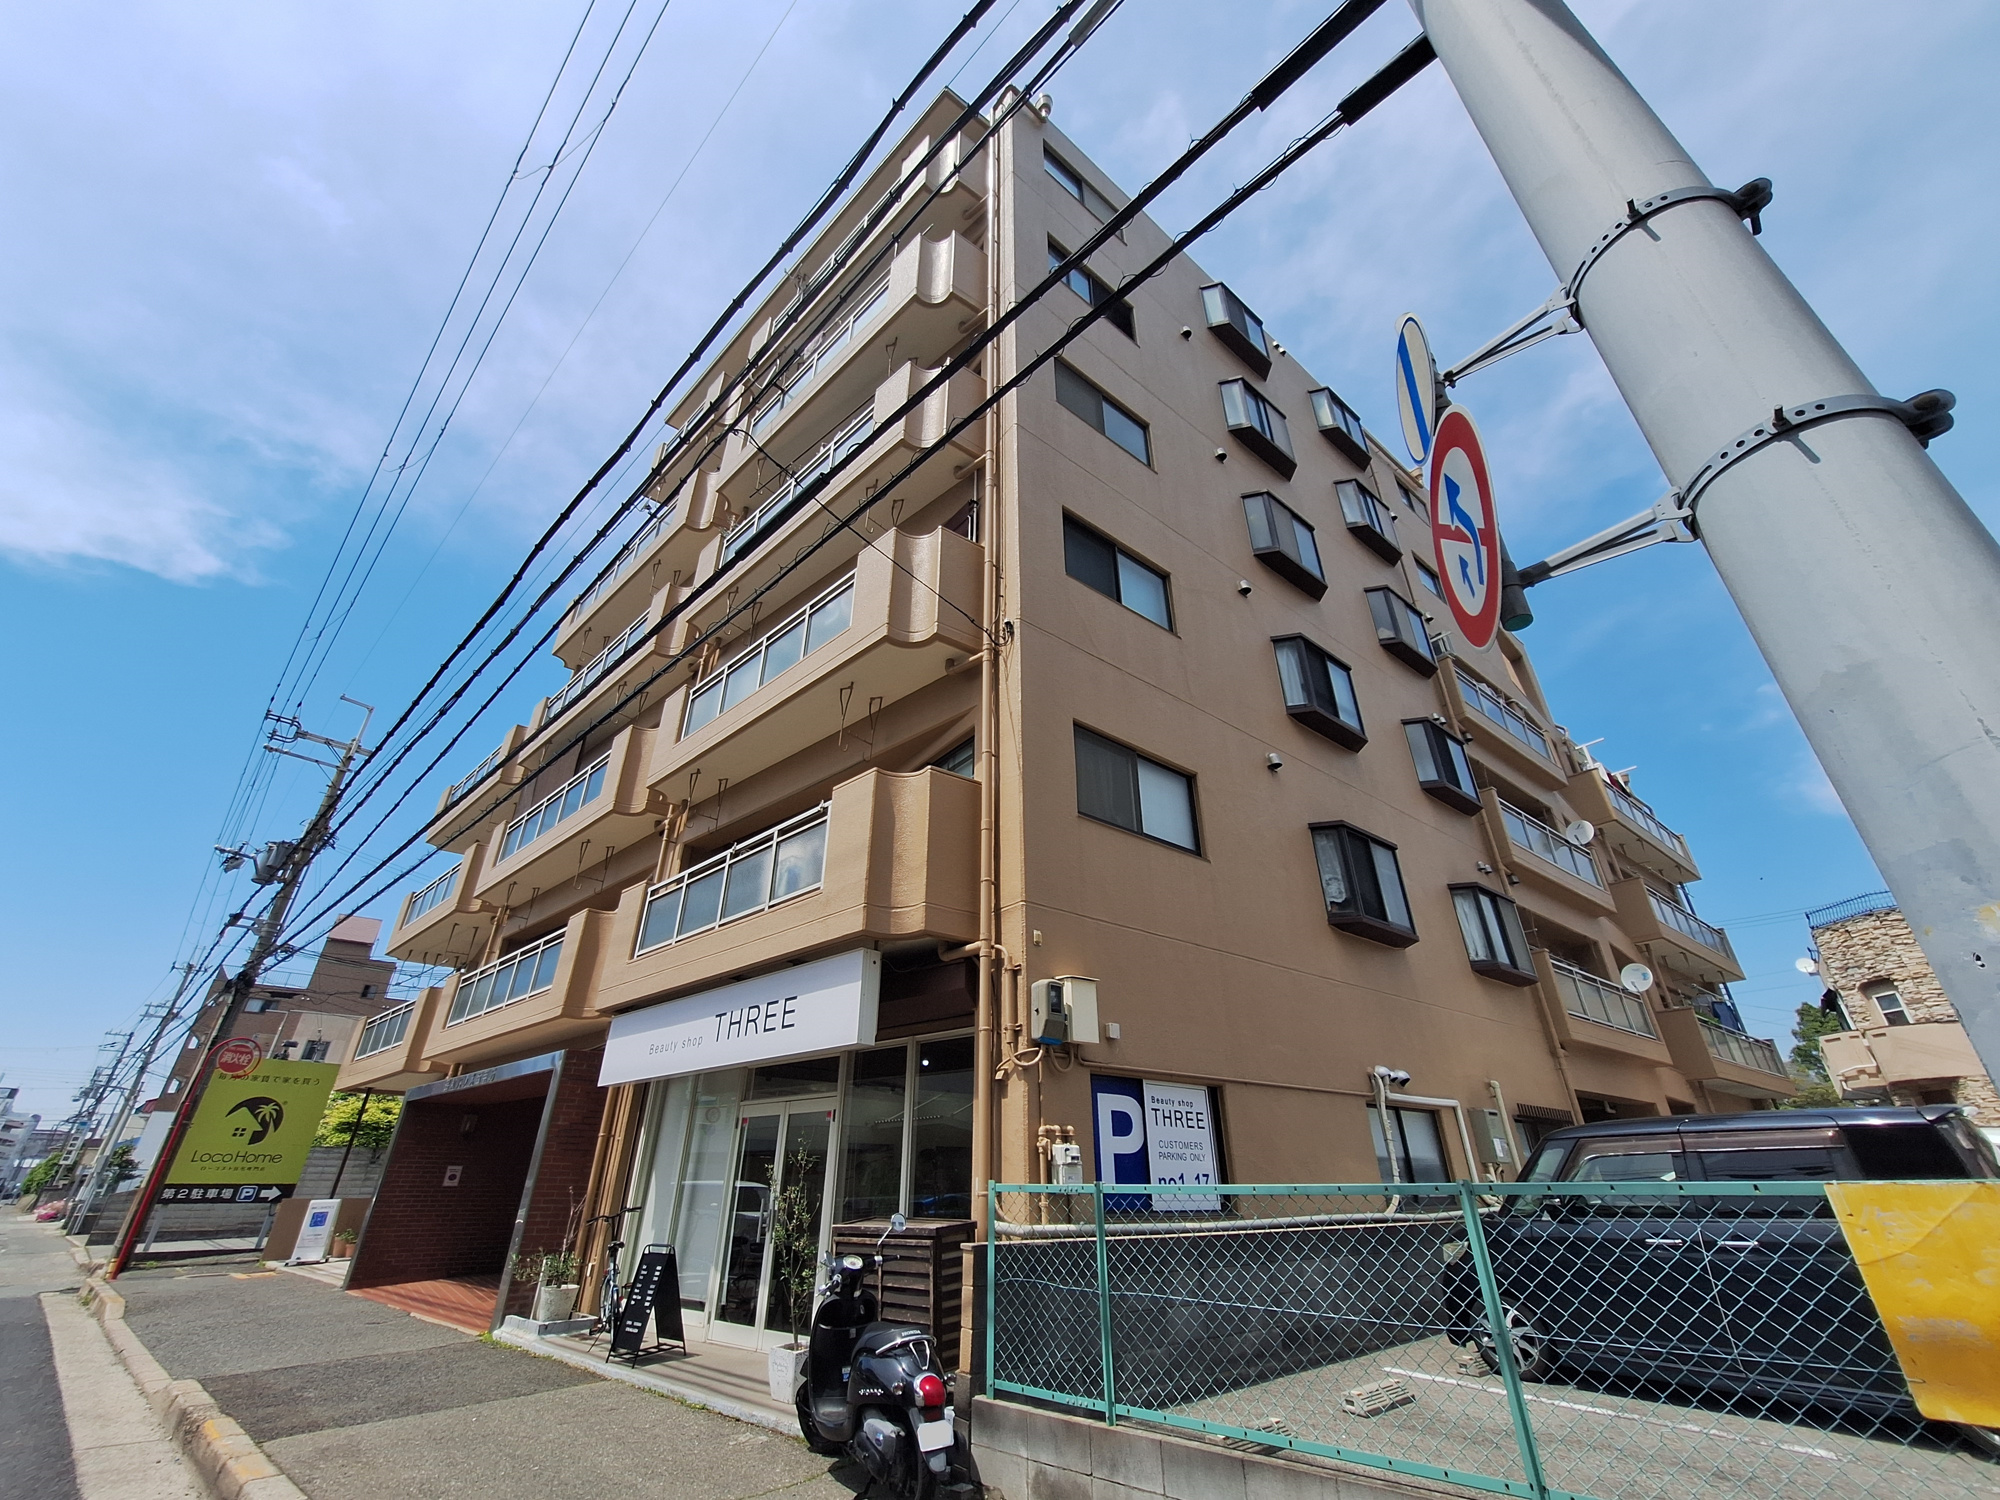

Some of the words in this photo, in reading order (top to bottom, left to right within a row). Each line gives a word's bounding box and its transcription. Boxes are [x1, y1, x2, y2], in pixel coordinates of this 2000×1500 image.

[649, 1041, 678, 1055] Beauty
[682, 1035, 703, 1049] shop
[715, 996, 798, 1042] THREE
[220, 1052, 252, 1065] 消火栓
[1151, 1096, 1175, 1106] Beauty
[1178, 1099, 1193, 1108] shop
[1151, 1108, 1205, 1129] THREE
[1097, 1093, 1144, 1184] P
[1158, 1140, 1203, 1151] CUSTOMERS
[1158, 1152, 1188, 1161] PARKING
[1190, 1153, 1206, 1161] ONLY
[161, 1188, 234, 1199] 第2駐車場
